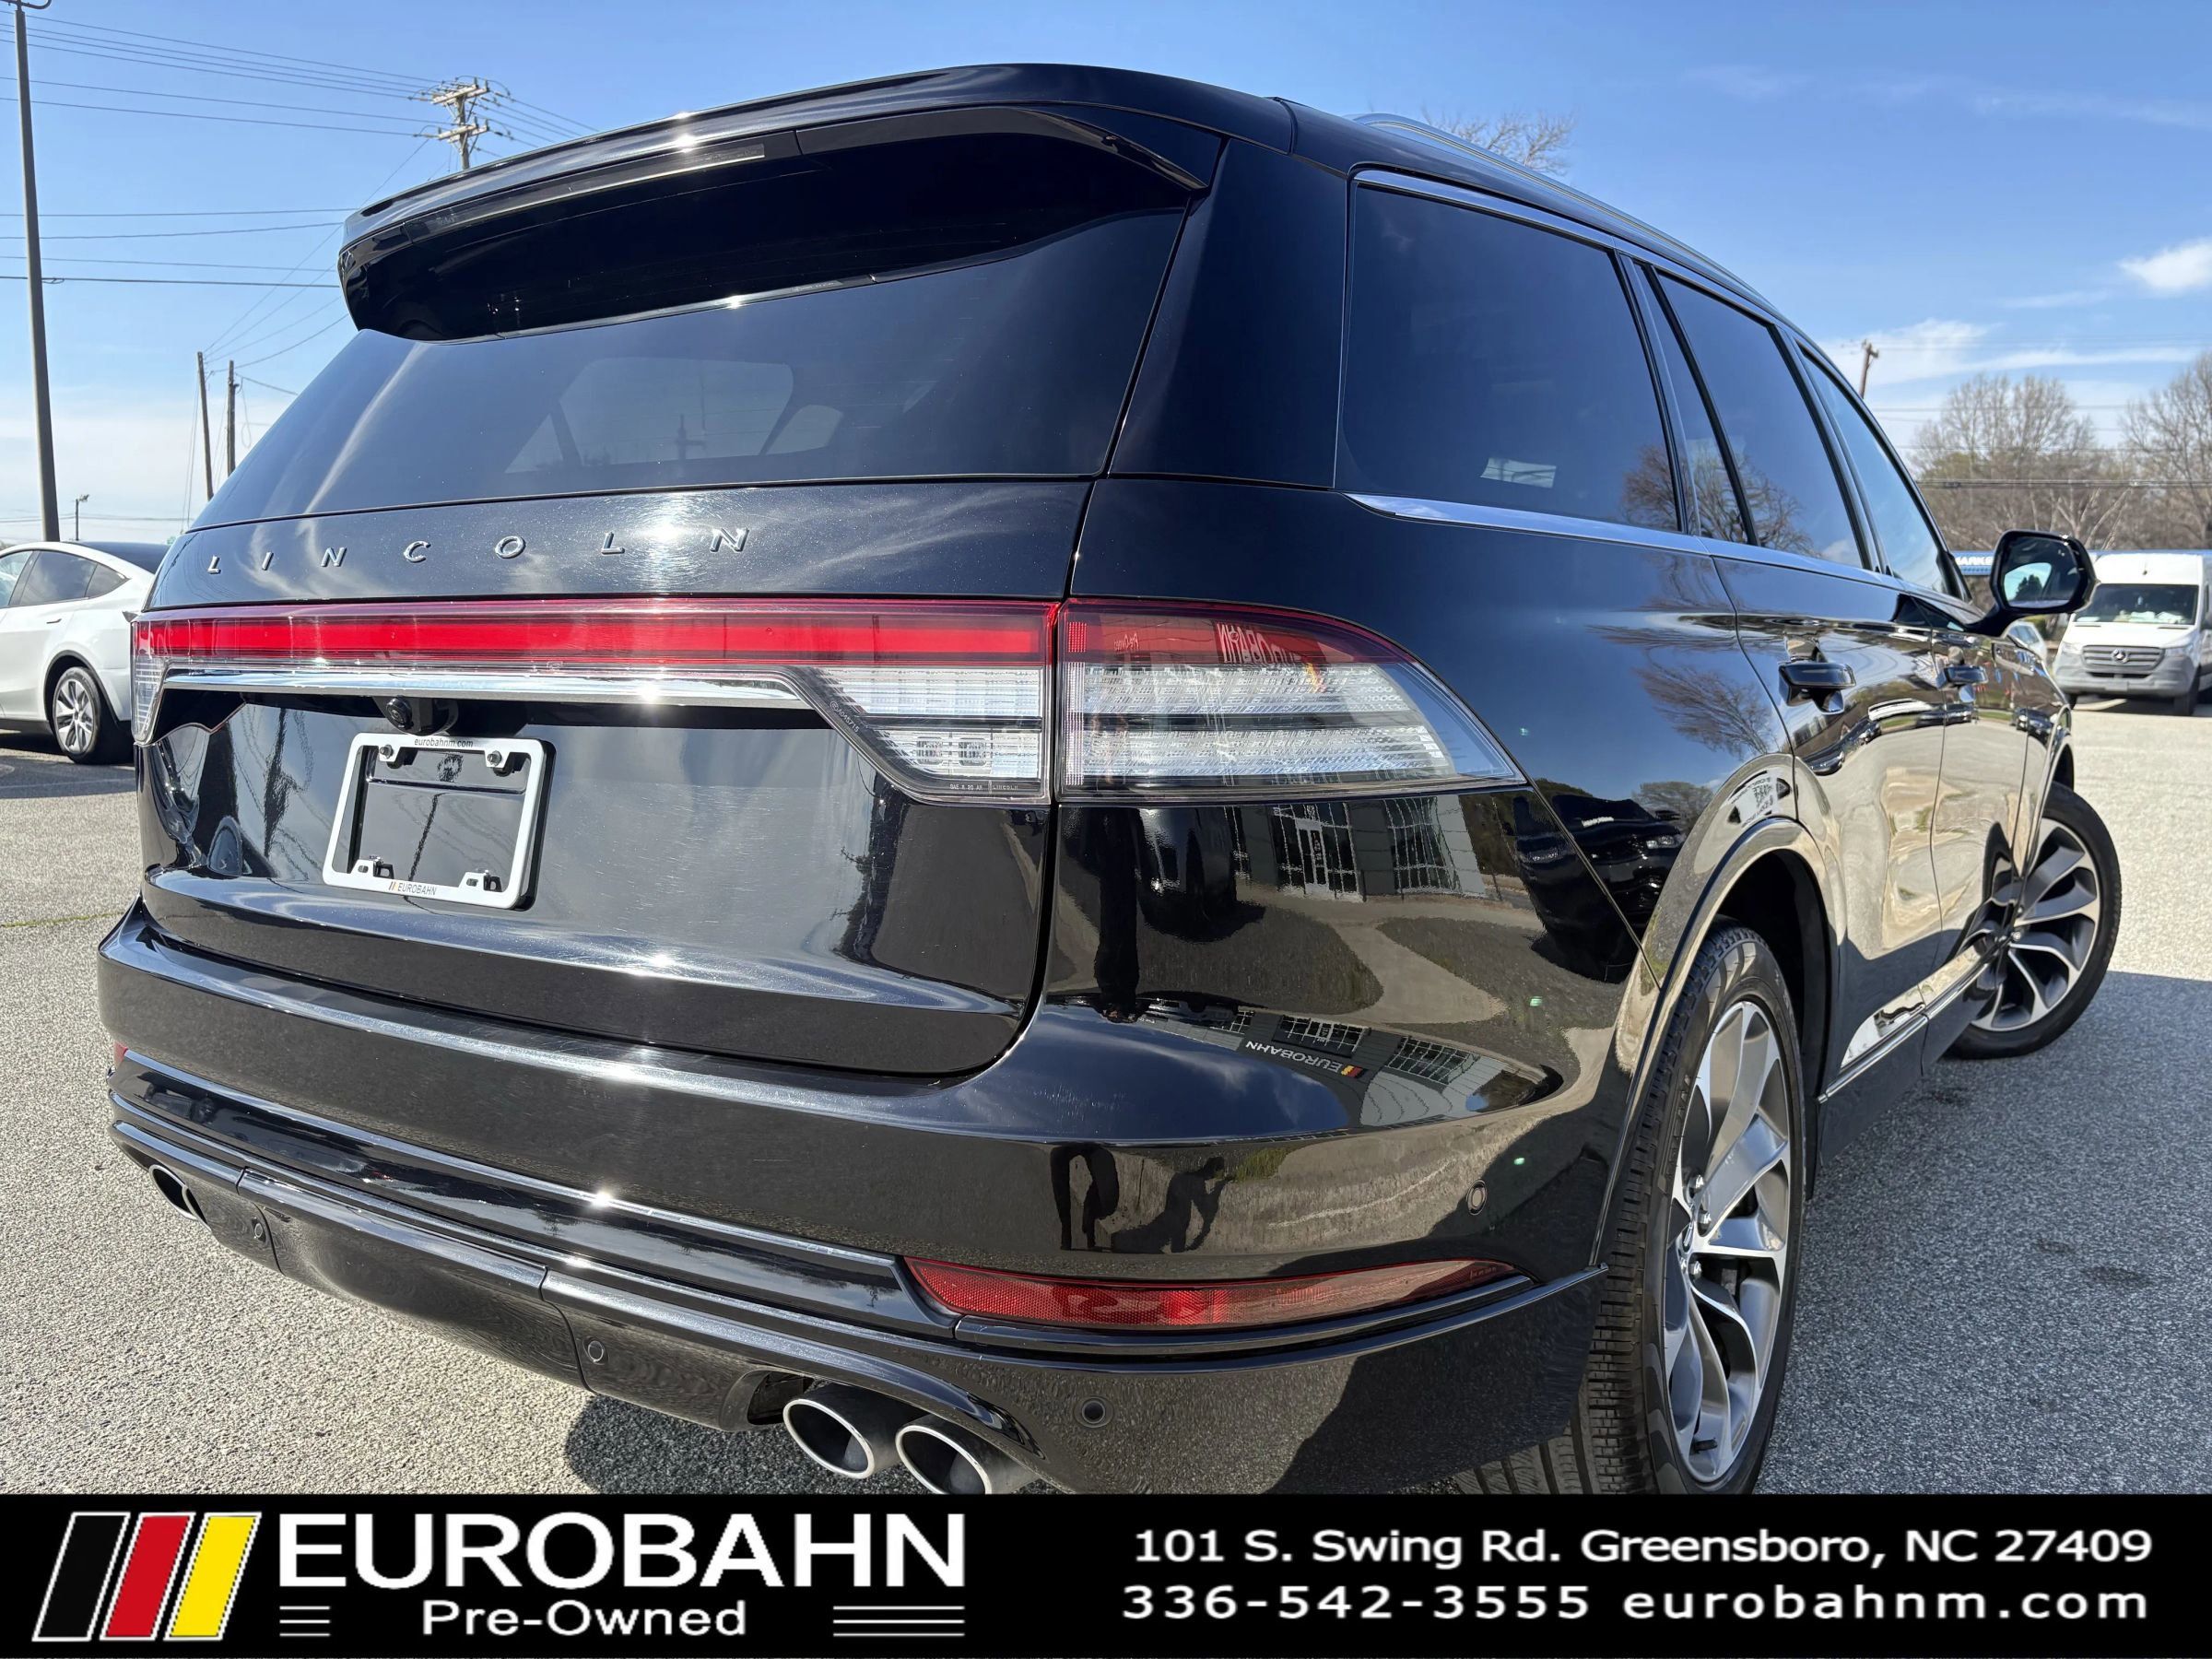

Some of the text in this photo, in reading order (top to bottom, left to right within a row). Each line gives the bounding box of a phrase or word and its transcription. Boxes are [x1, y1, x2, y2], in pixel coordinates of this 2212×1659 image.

[207, 527, 749, 574] LINCOLN
[414, 736, 474, 748] eurobahnm.com
[397, 882, 437, 896] EUROBAHN
